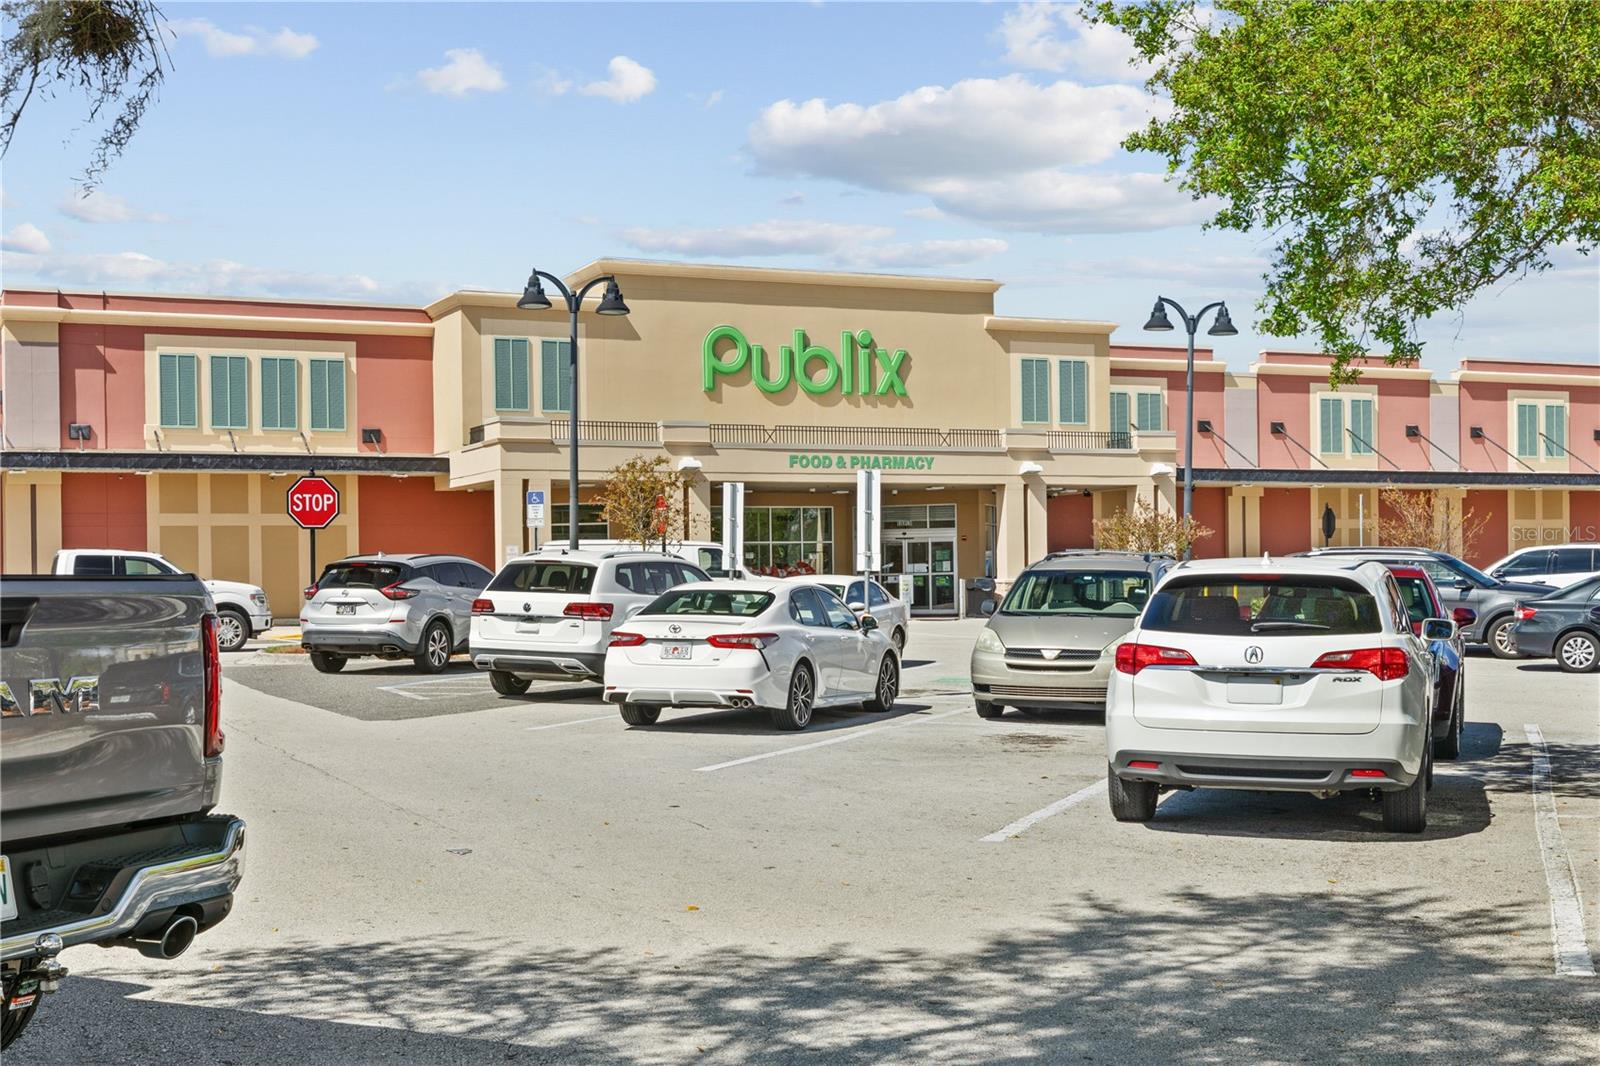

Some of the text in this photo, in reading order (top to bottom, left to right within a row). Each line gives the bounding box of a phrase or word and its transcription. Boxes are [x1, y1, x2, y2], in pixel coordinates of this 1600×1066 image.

[703, 324, 908, 397] Publix
[789, 455, 935, 470] FOOD & PHARMACY
[293, 493, 334, 512] STOP
